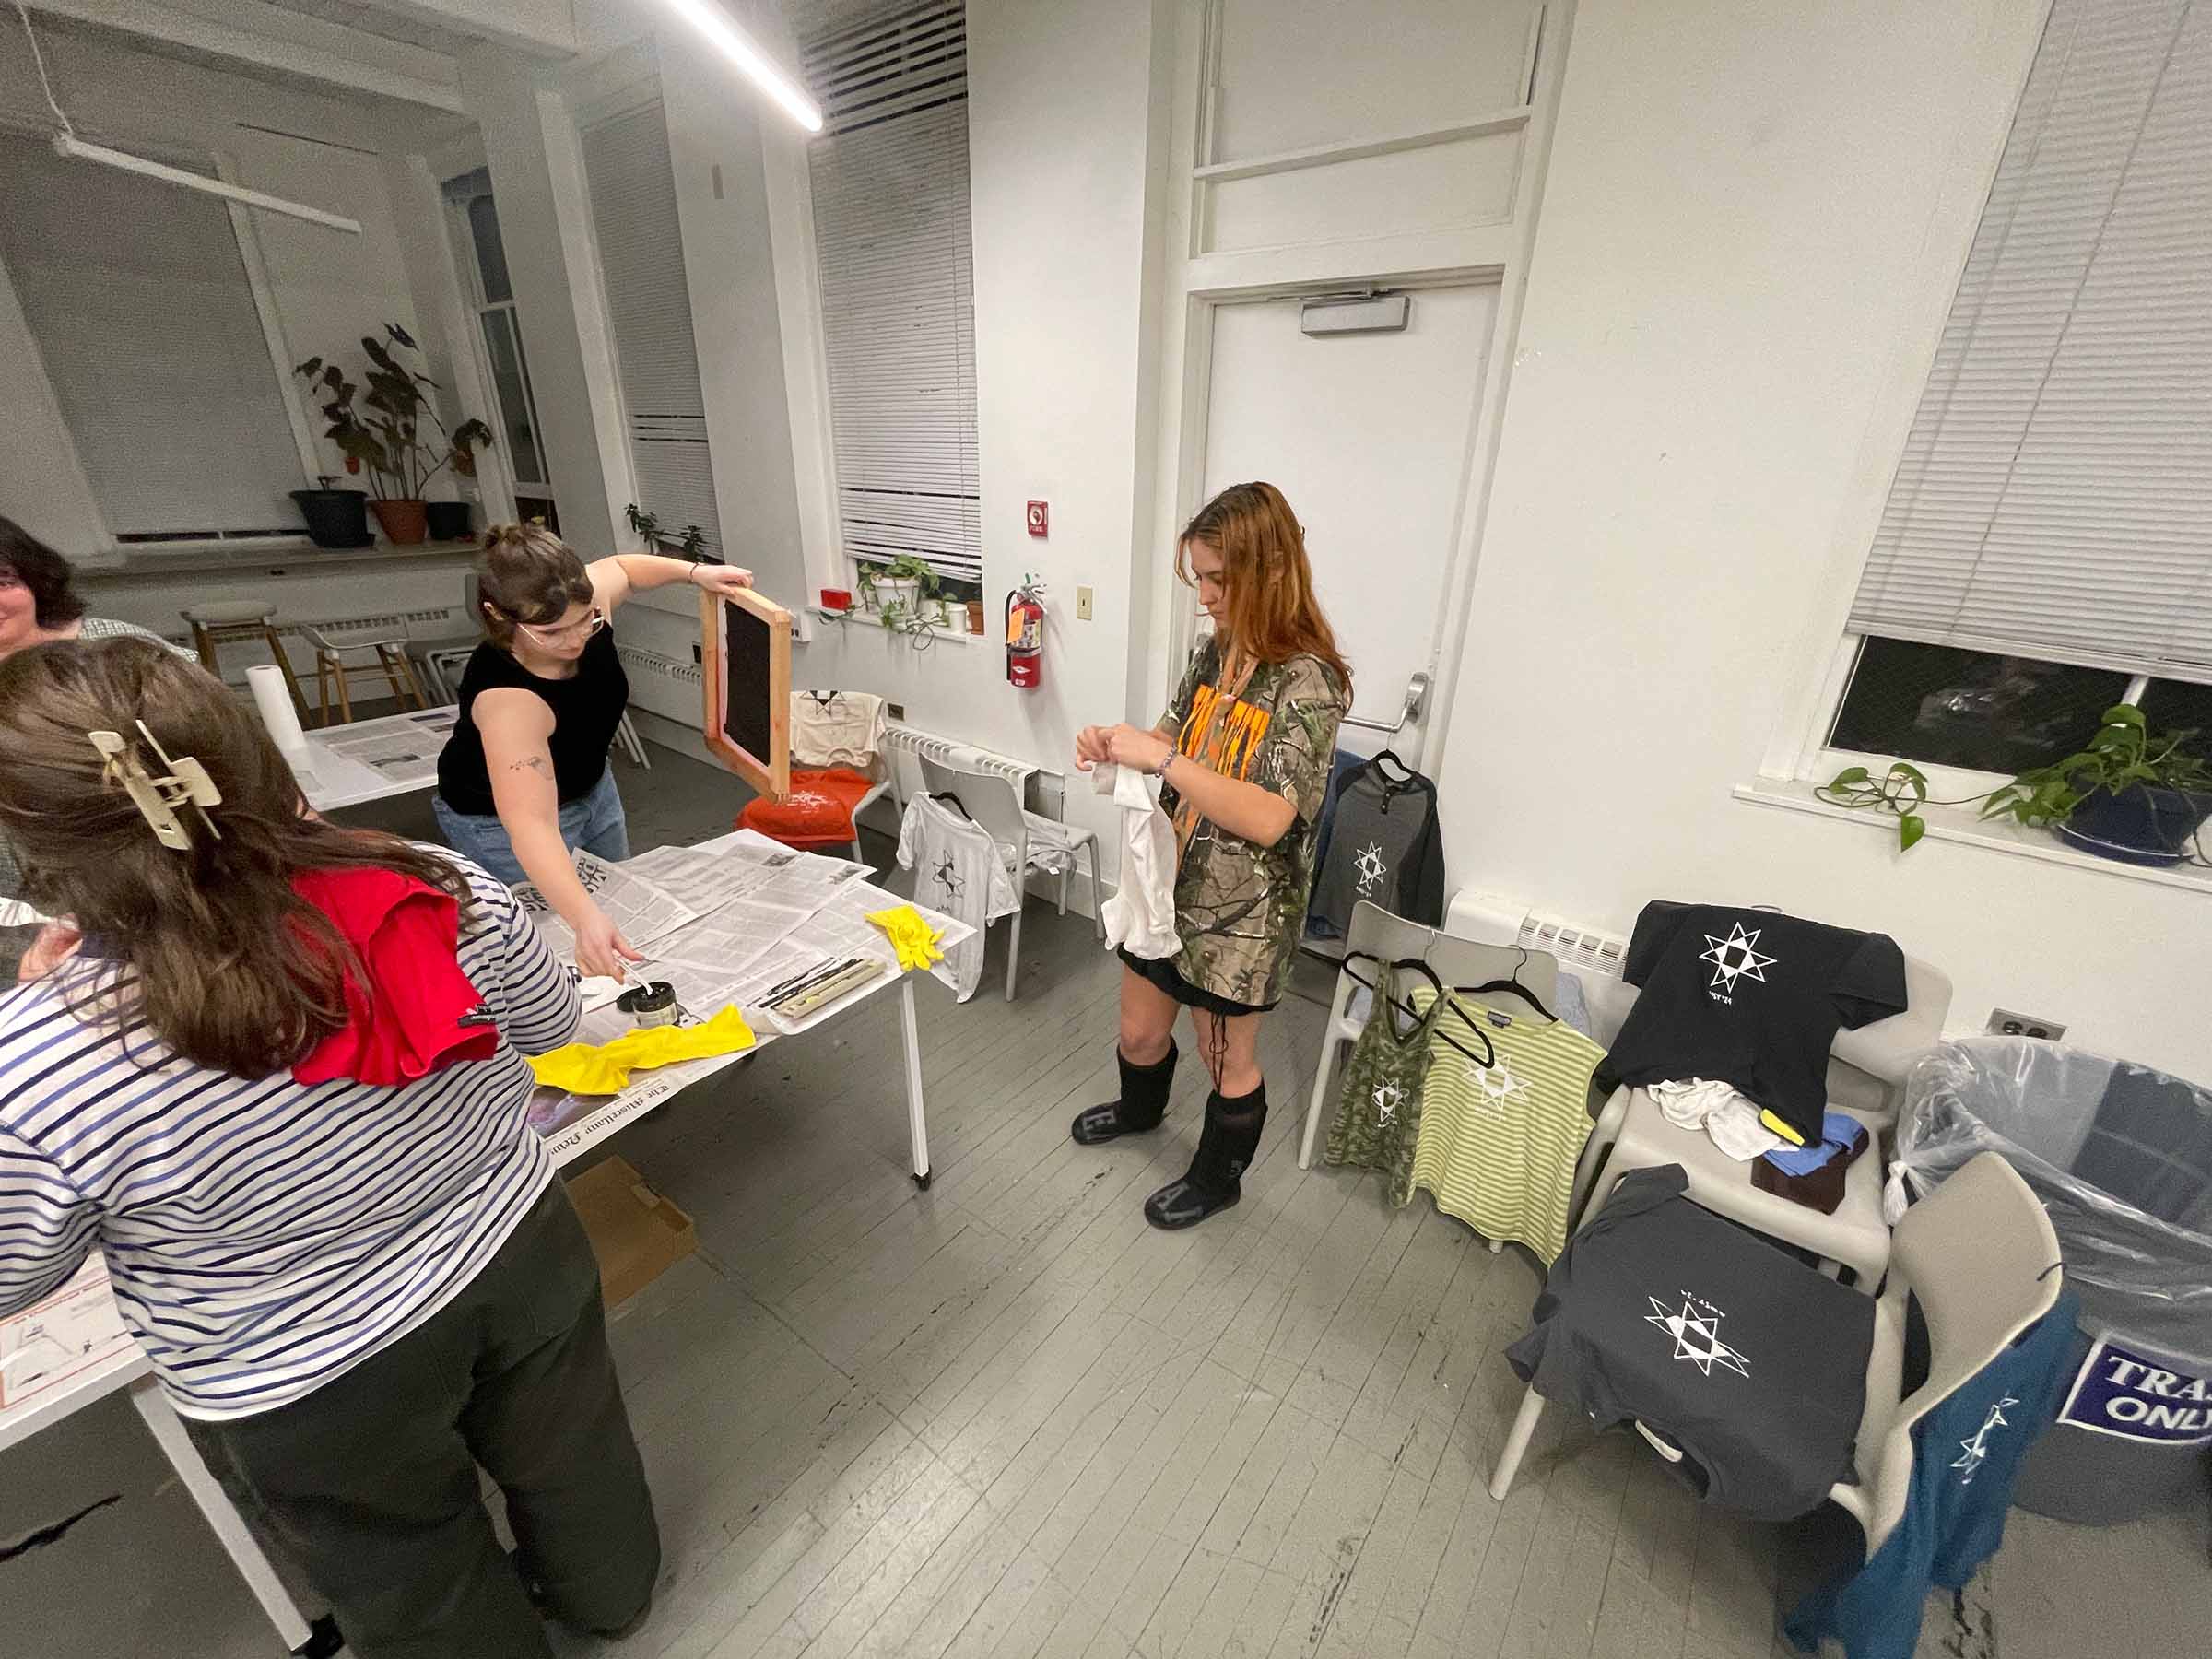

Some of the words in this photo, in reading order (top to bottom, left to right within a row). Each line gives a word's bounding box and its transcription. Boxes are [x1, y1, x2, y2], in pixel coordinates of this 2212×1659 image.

[647, 1085, 670, 1099] The
[585, 1097, 644, 1135] Miscellany
[2104, 1356, 2212, 1402] TRA
